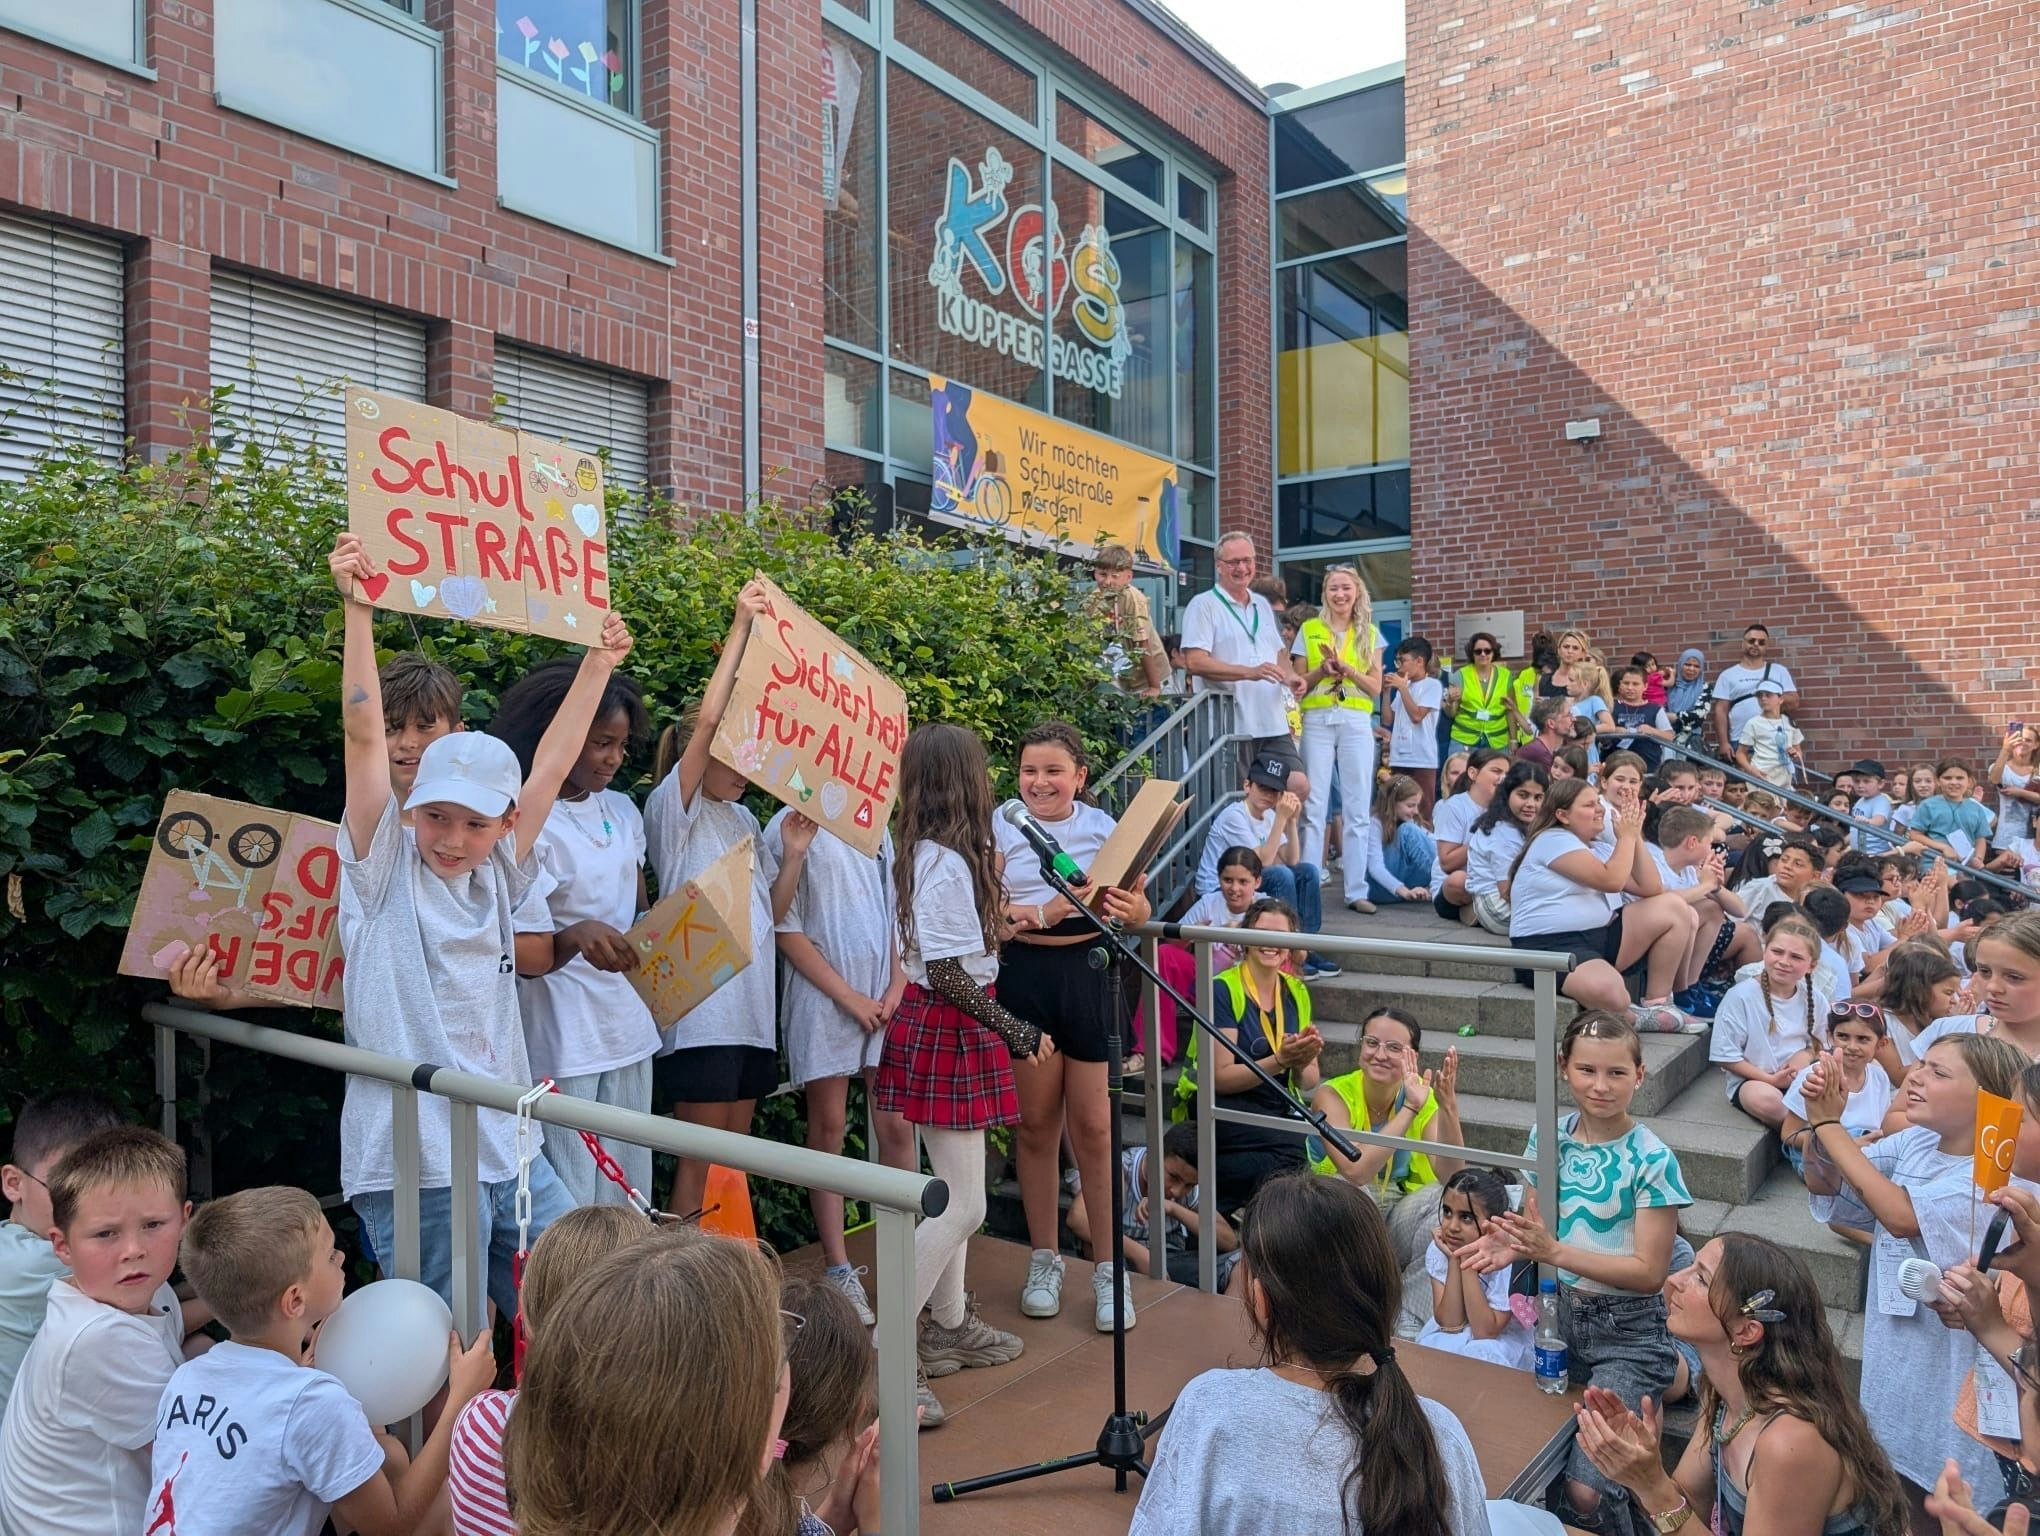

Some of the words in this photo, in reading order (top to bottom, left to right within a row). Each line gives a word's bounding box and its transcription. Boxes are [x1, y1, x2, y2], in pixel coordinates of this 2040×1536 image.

[938, 159, 1119, 344] KGS
[938, 290, 1121, 396] KUPFERGASSE
[371, 426, 535, 521] Schul
[1019, 427, 1047, 456] Wir
[1052, 443, 1118, 481] möchten
[1019, 457, 1113, 506] Schulstraße
[386, 508, 608, 610] STRAßE
[814, 723, 895, 804] ALLE
[155, 1393, 248, 1460] ARIS
